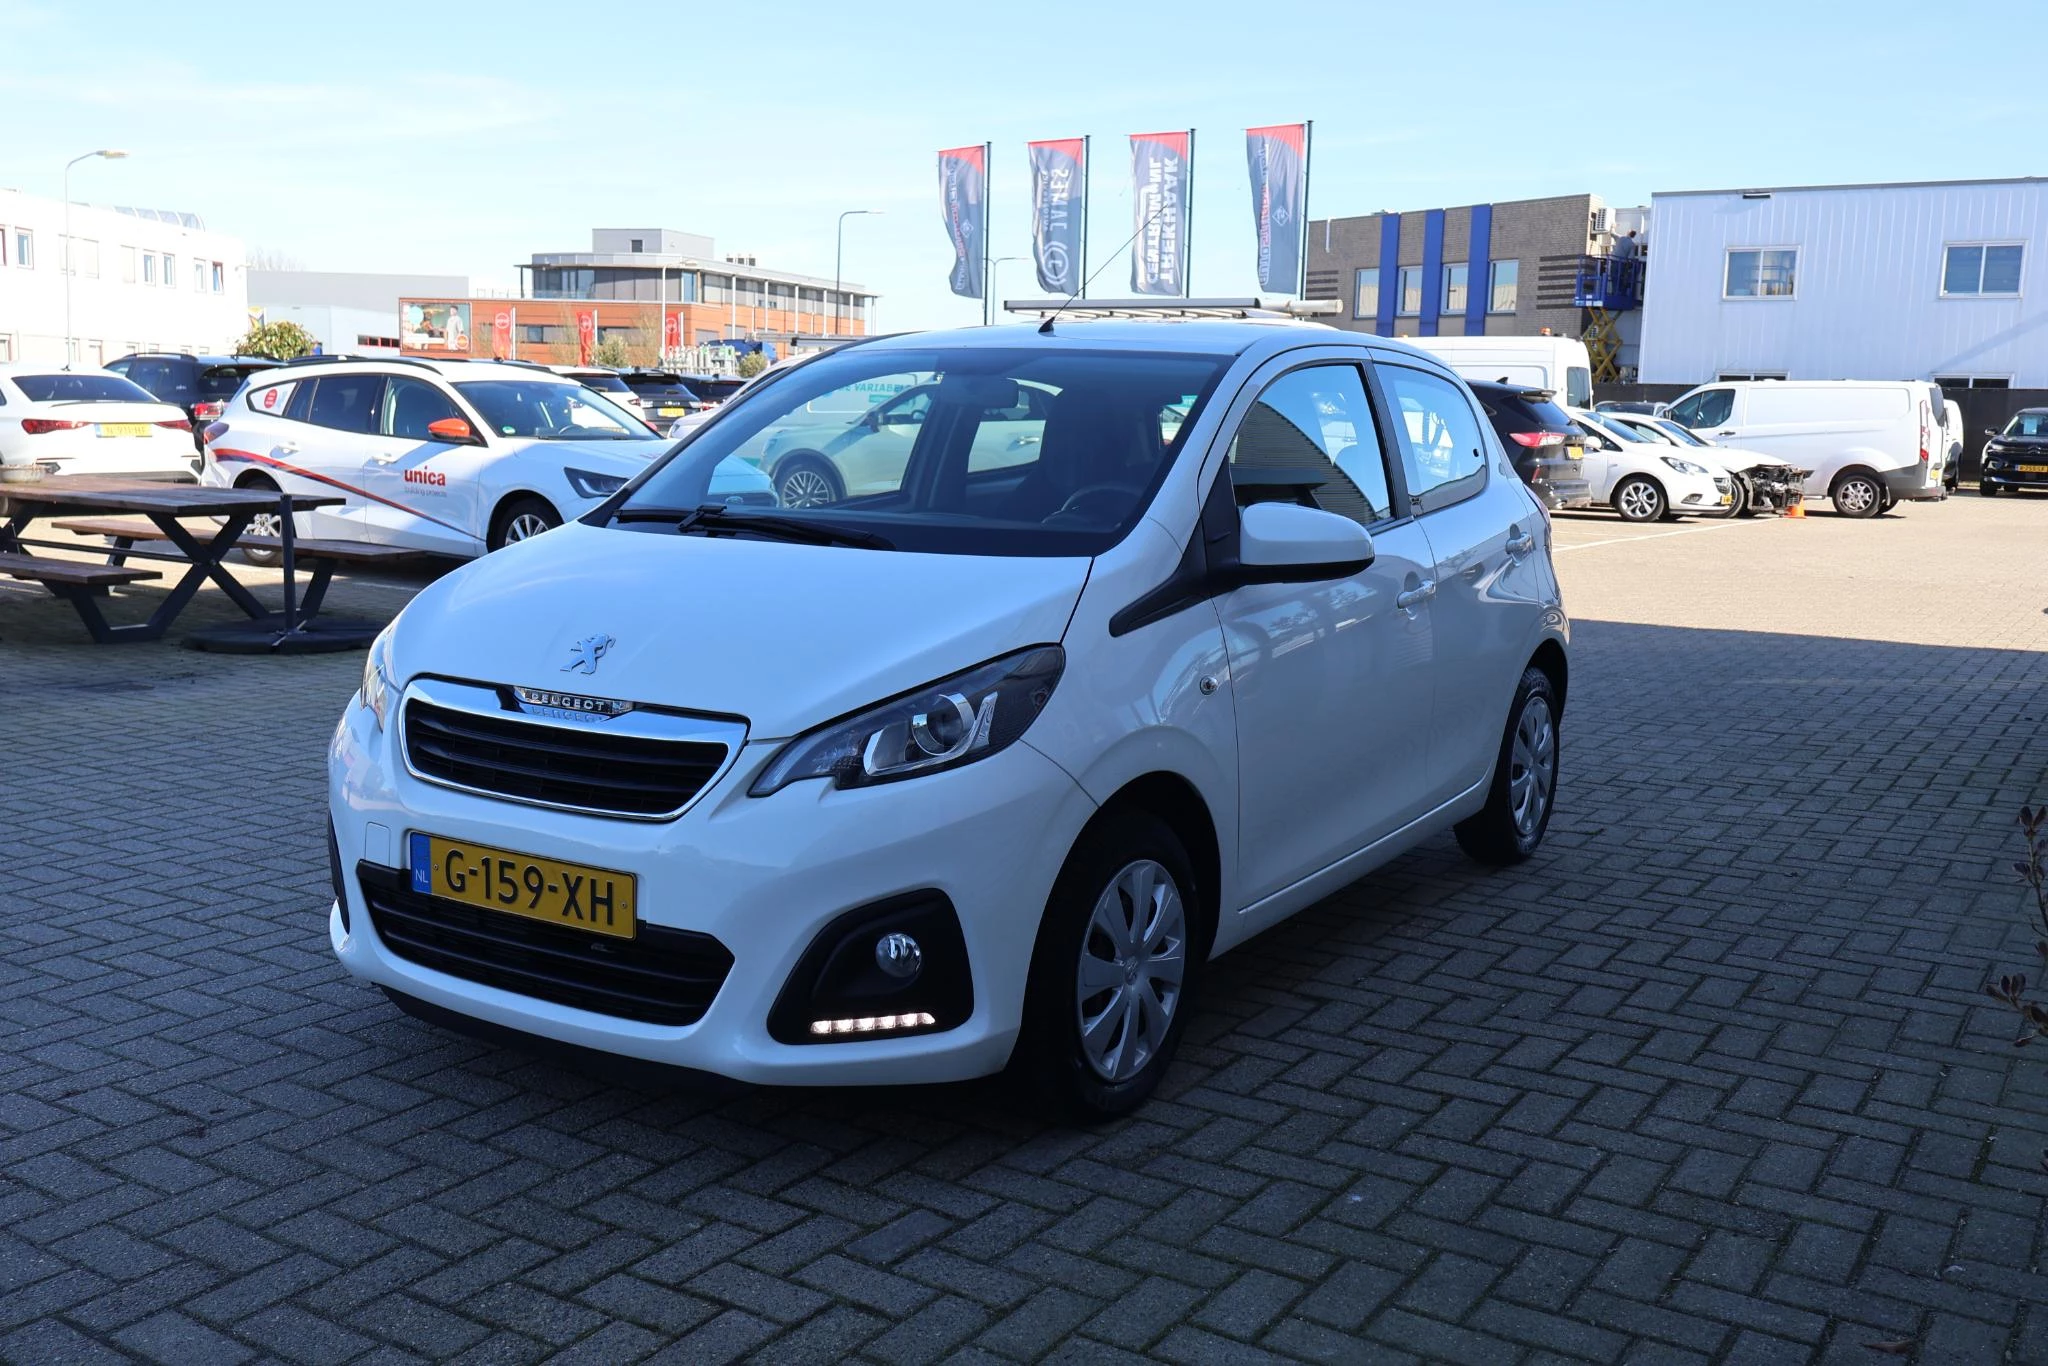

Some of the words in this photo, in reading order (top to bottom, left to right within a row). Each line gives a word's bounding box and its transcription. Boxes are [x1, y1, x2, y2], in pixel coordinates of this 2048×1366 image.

[404, 465, 446, 486] unica
[531, 692, 605, 711] PEUGEOT
[415, 870, 429, 883] NL
[445, 849, 614, 925] G-159-XH
